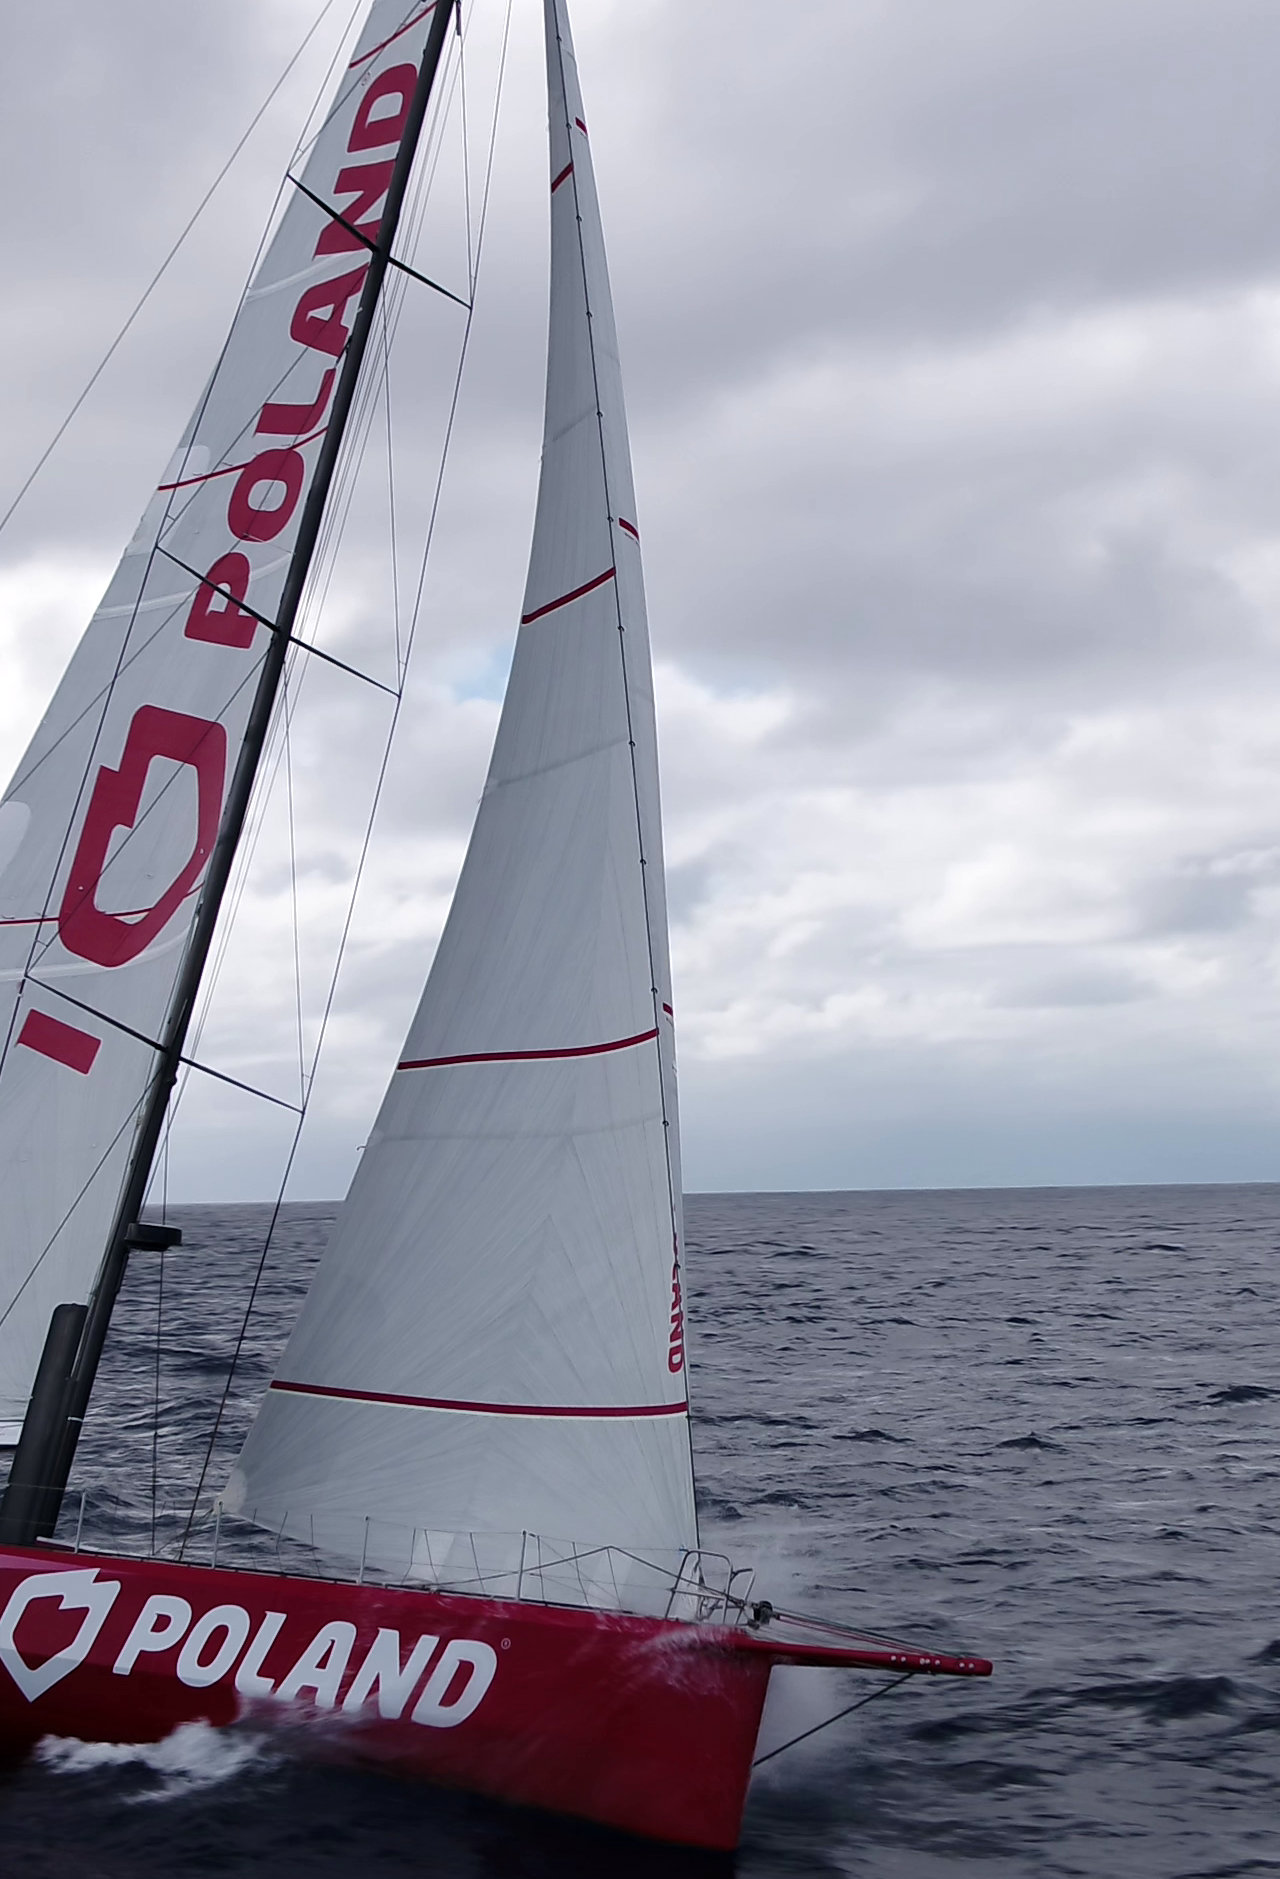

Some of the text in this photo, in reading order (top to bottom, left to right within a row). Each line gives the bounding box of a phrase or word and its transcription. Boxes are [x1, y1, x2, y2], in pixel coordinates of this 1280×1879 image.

[17, 62, 418, 1076] I POLAND
[112, 1594, 498, 1728] POLAND
